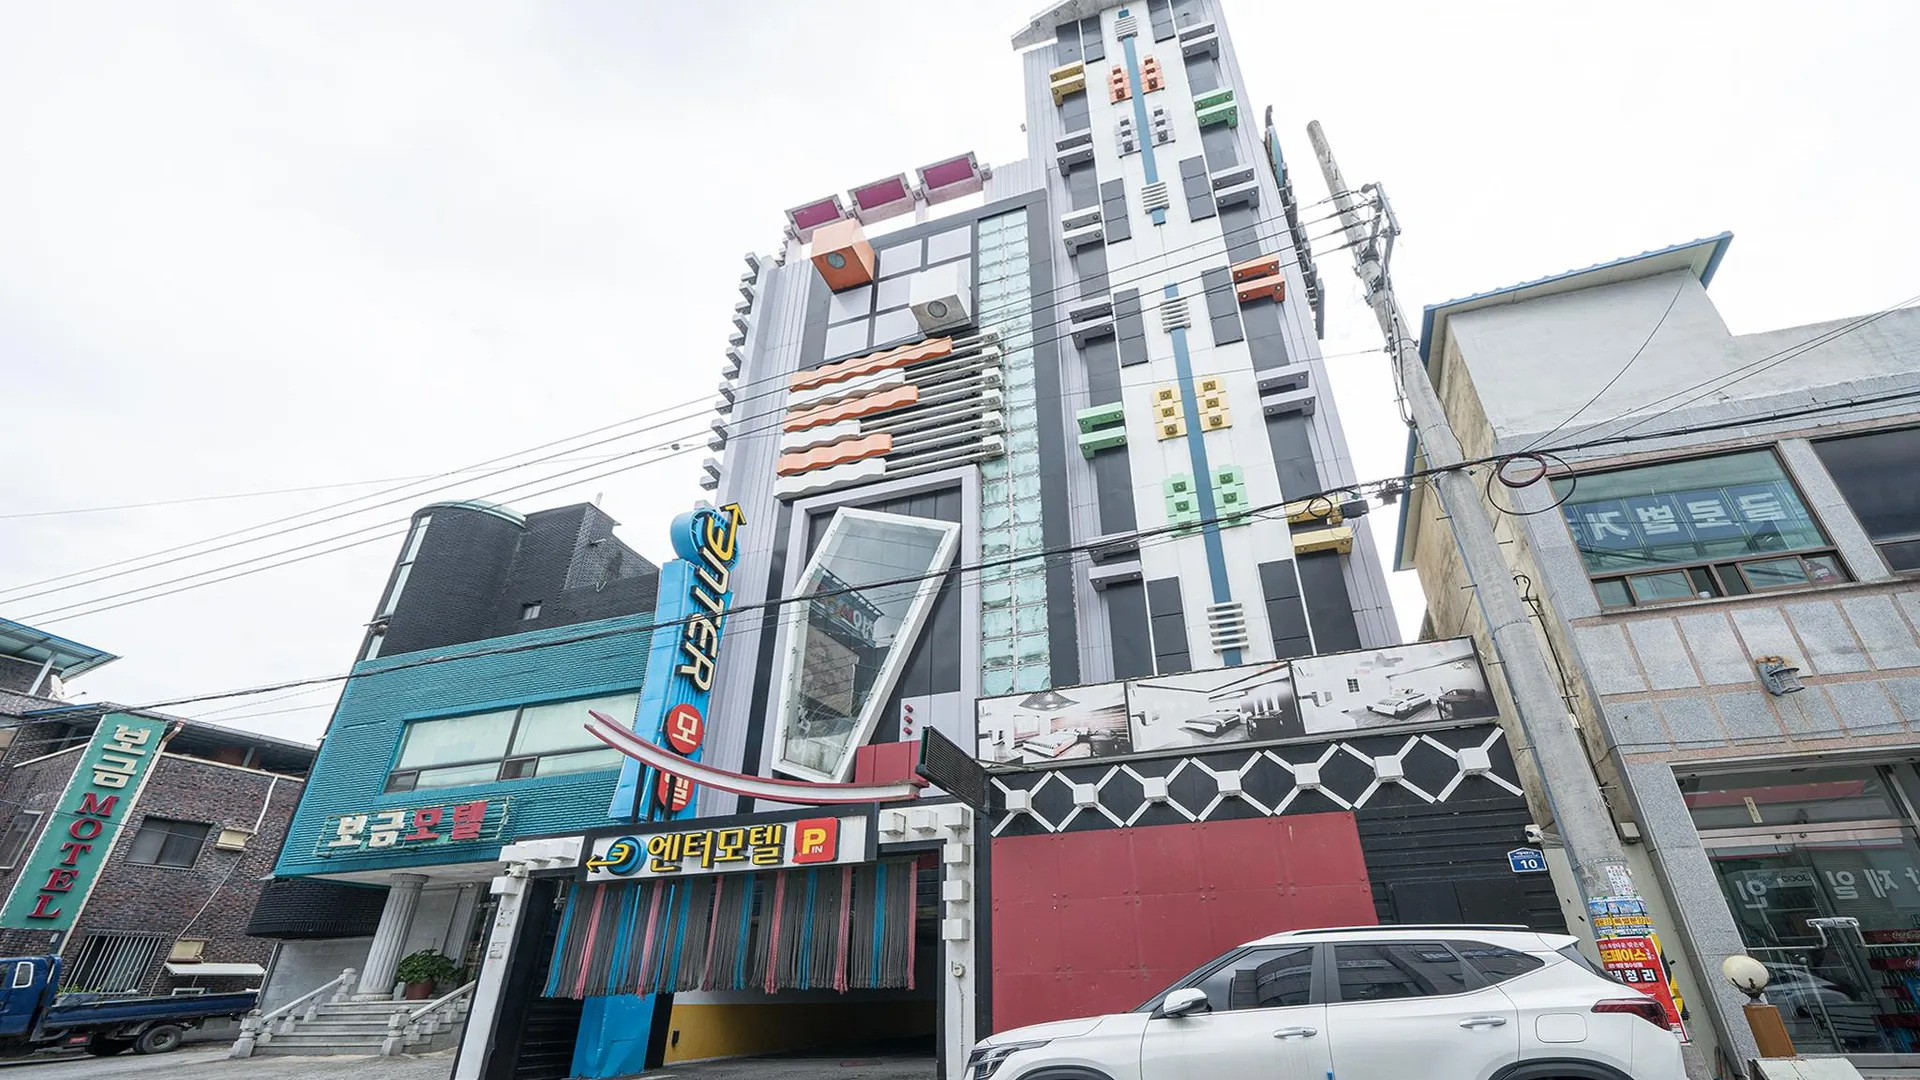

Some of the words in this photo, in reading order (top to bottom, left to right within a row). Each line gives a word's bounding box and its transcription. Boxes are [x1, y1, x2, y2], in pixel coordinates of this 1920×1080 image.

[93, 725, 151, 788] 보금
[27, 792, 120, 919] MOTEL
[648, 824, 785, 872] 엔터모텔
[802, 828, 827, 854] P
[812, 845, 824, 854] IN
[1520, 859, 1538, 869] 10
